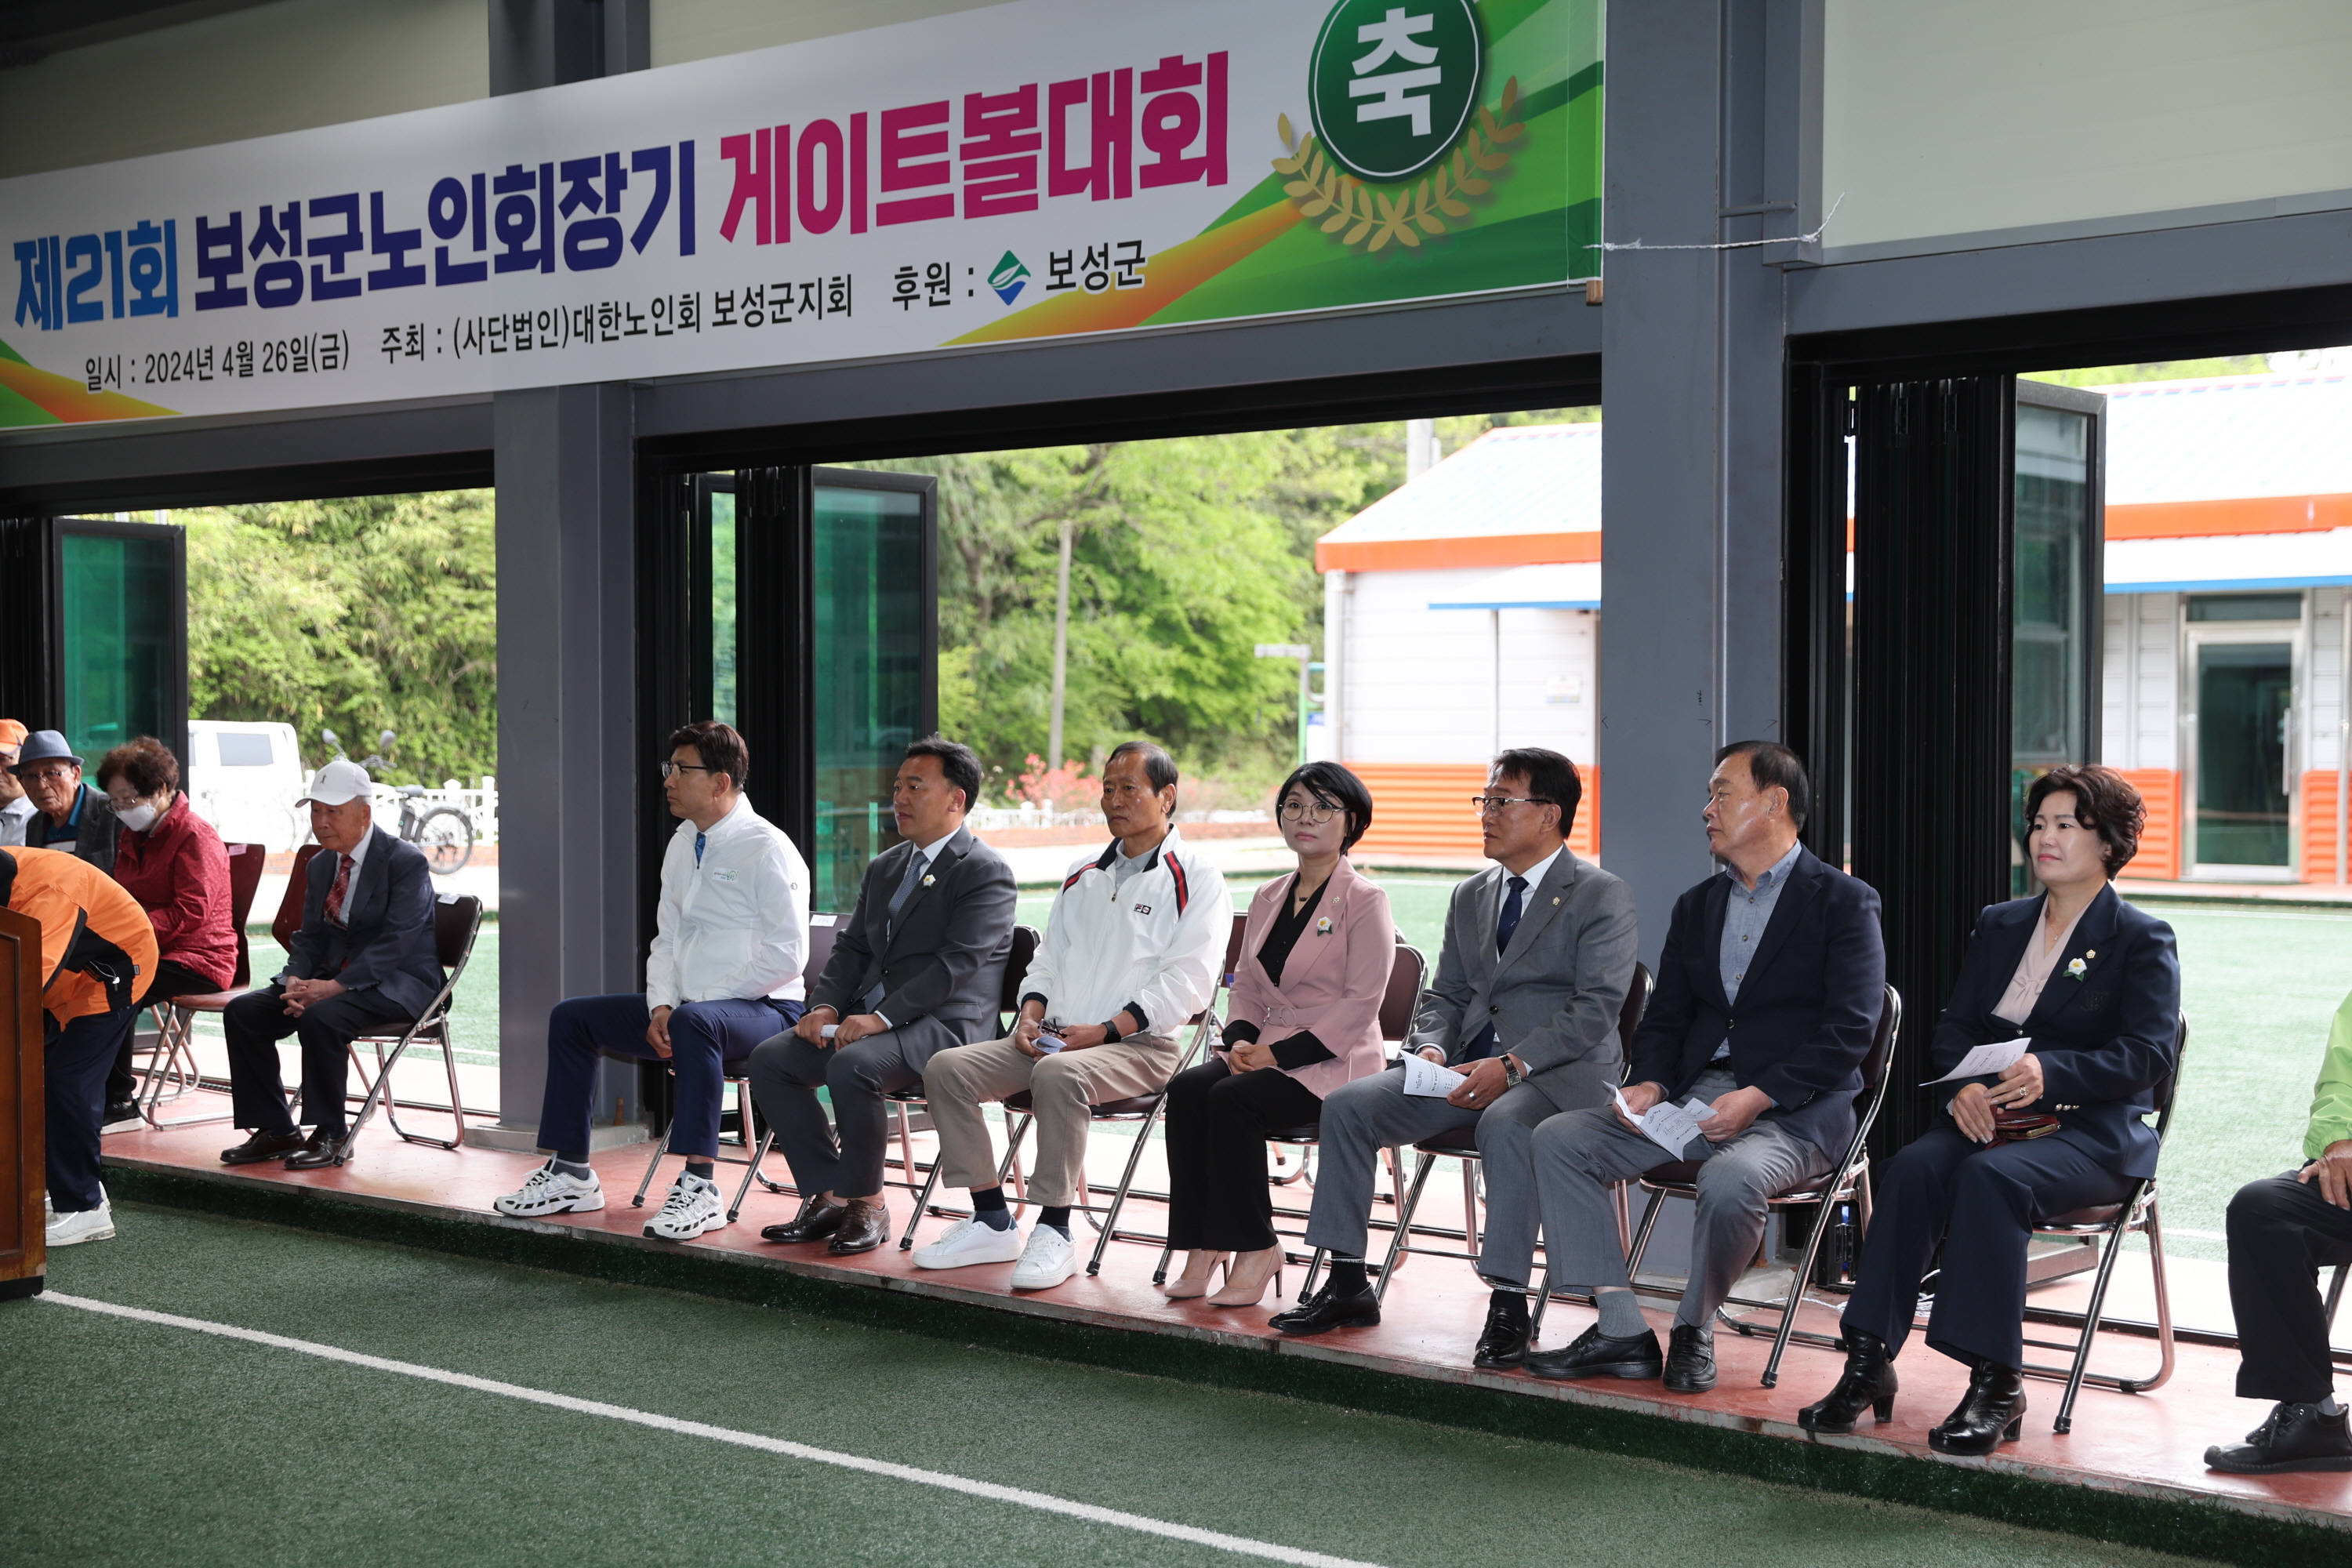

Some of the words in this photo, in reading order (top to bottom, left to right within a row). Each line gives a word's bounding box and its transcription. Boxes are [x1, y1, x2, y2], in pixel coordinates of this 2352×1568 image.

[1350, 8, 1442, 137] 축
[13, 218, 179, 332] 제21회
[195, 140, 695, 309] 보성군노인회장기
[720, 50, 1229, 245] 게이트볼대회
[381, 322, 424, 365] 주최
[453, 292, 700, 359] (사단법인)대한노인회
[712, 274, 851, 328] 보성군지회
[892, 262, 951, 311] 후원
[1046, 241, 1145, 291] 보성군
[85, 354, 121, 392] 일시
[144, 345, 214, 384] 2024년
[222, 340, 254, 379] 4월
[262, 329, 349, 373] 26일(금)
